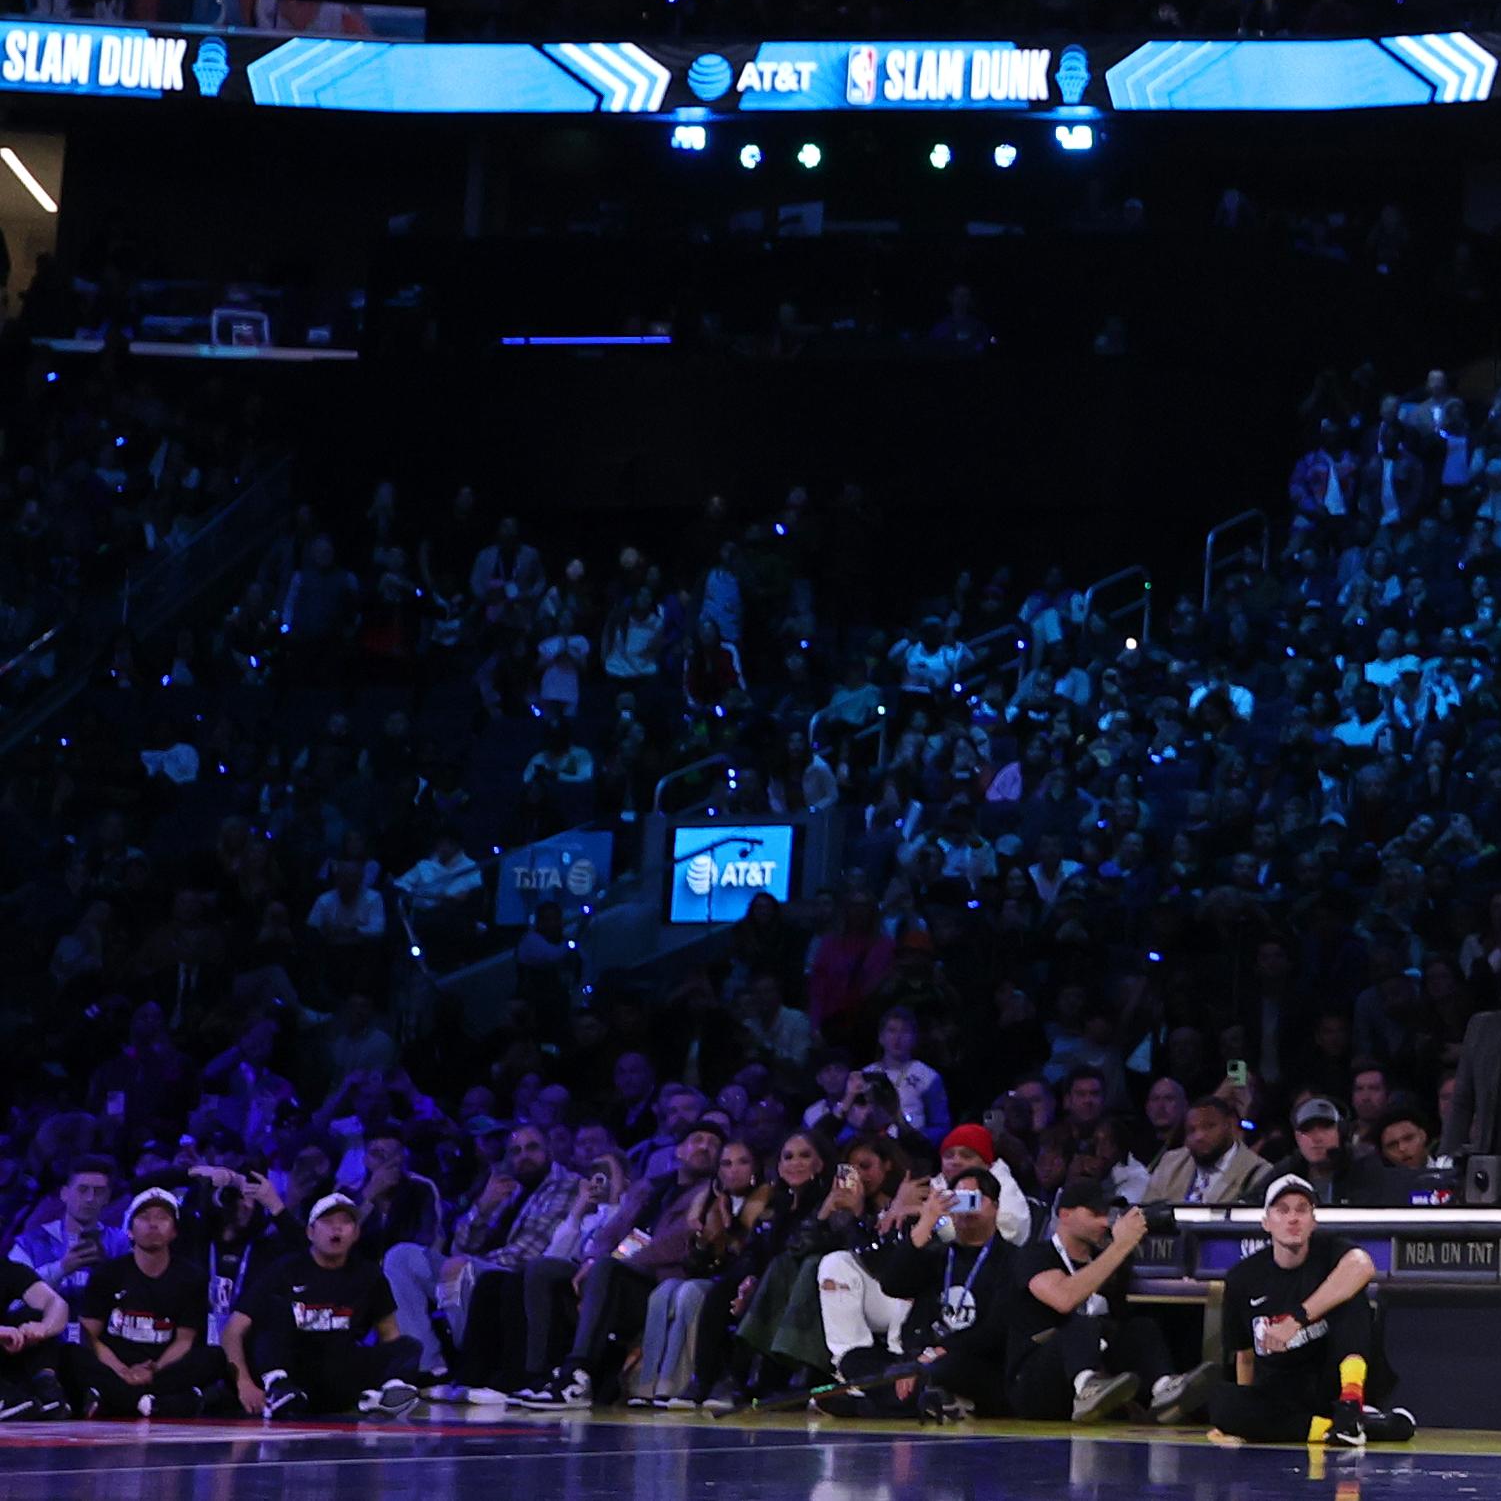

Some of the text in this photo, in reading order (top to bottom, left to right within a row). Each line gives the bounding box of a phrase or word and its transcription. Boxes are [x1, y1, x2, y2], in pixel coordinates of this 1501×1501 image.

[3, 29, 187, 91] SLAM DUNK
[736, 48, 1051, 100] AT&T SLAM DUNK
[720, 861, 777, 887] AT&T
[1150, 1238, 1174, 1260] TNT
[1406, 1241, 1494, 1265] NBA ON TNT
